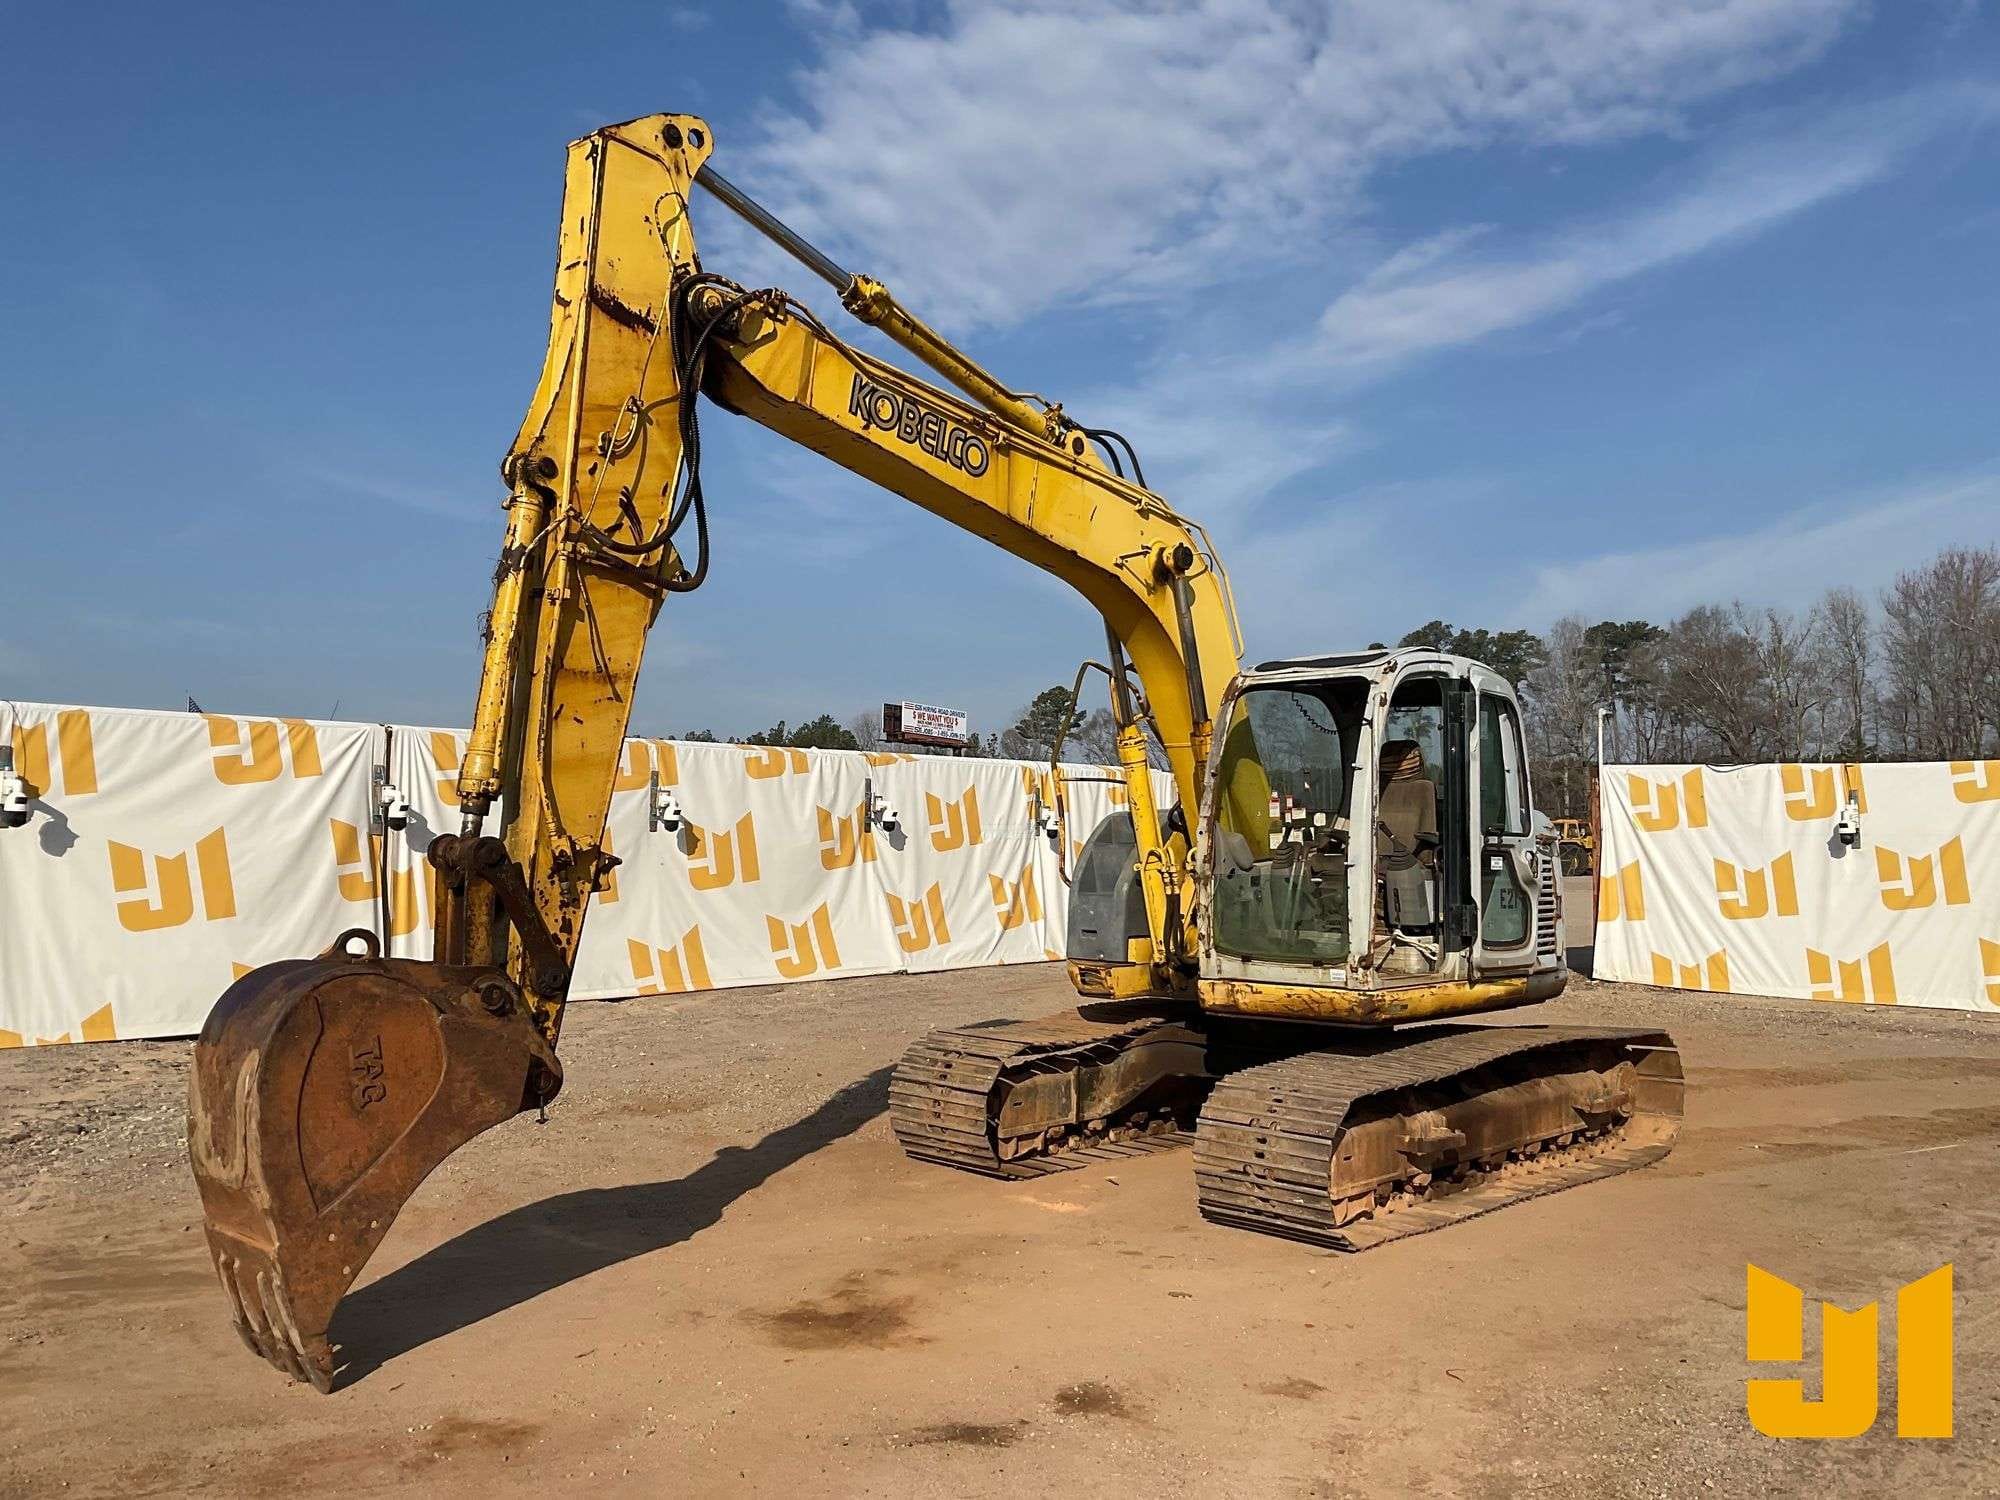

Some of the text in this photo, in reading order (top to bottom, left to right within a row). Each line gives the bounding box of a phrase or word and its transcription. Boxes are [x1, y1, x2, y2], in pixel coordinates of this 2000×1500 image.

[849, 371, 989, 478] KOBELCO
[918, 712, 926, 720] WE
[927, 714, 942, 722] WANT
[943, 715, 954, 724] YOU
[352, 1035, 387, 1110] TAG
